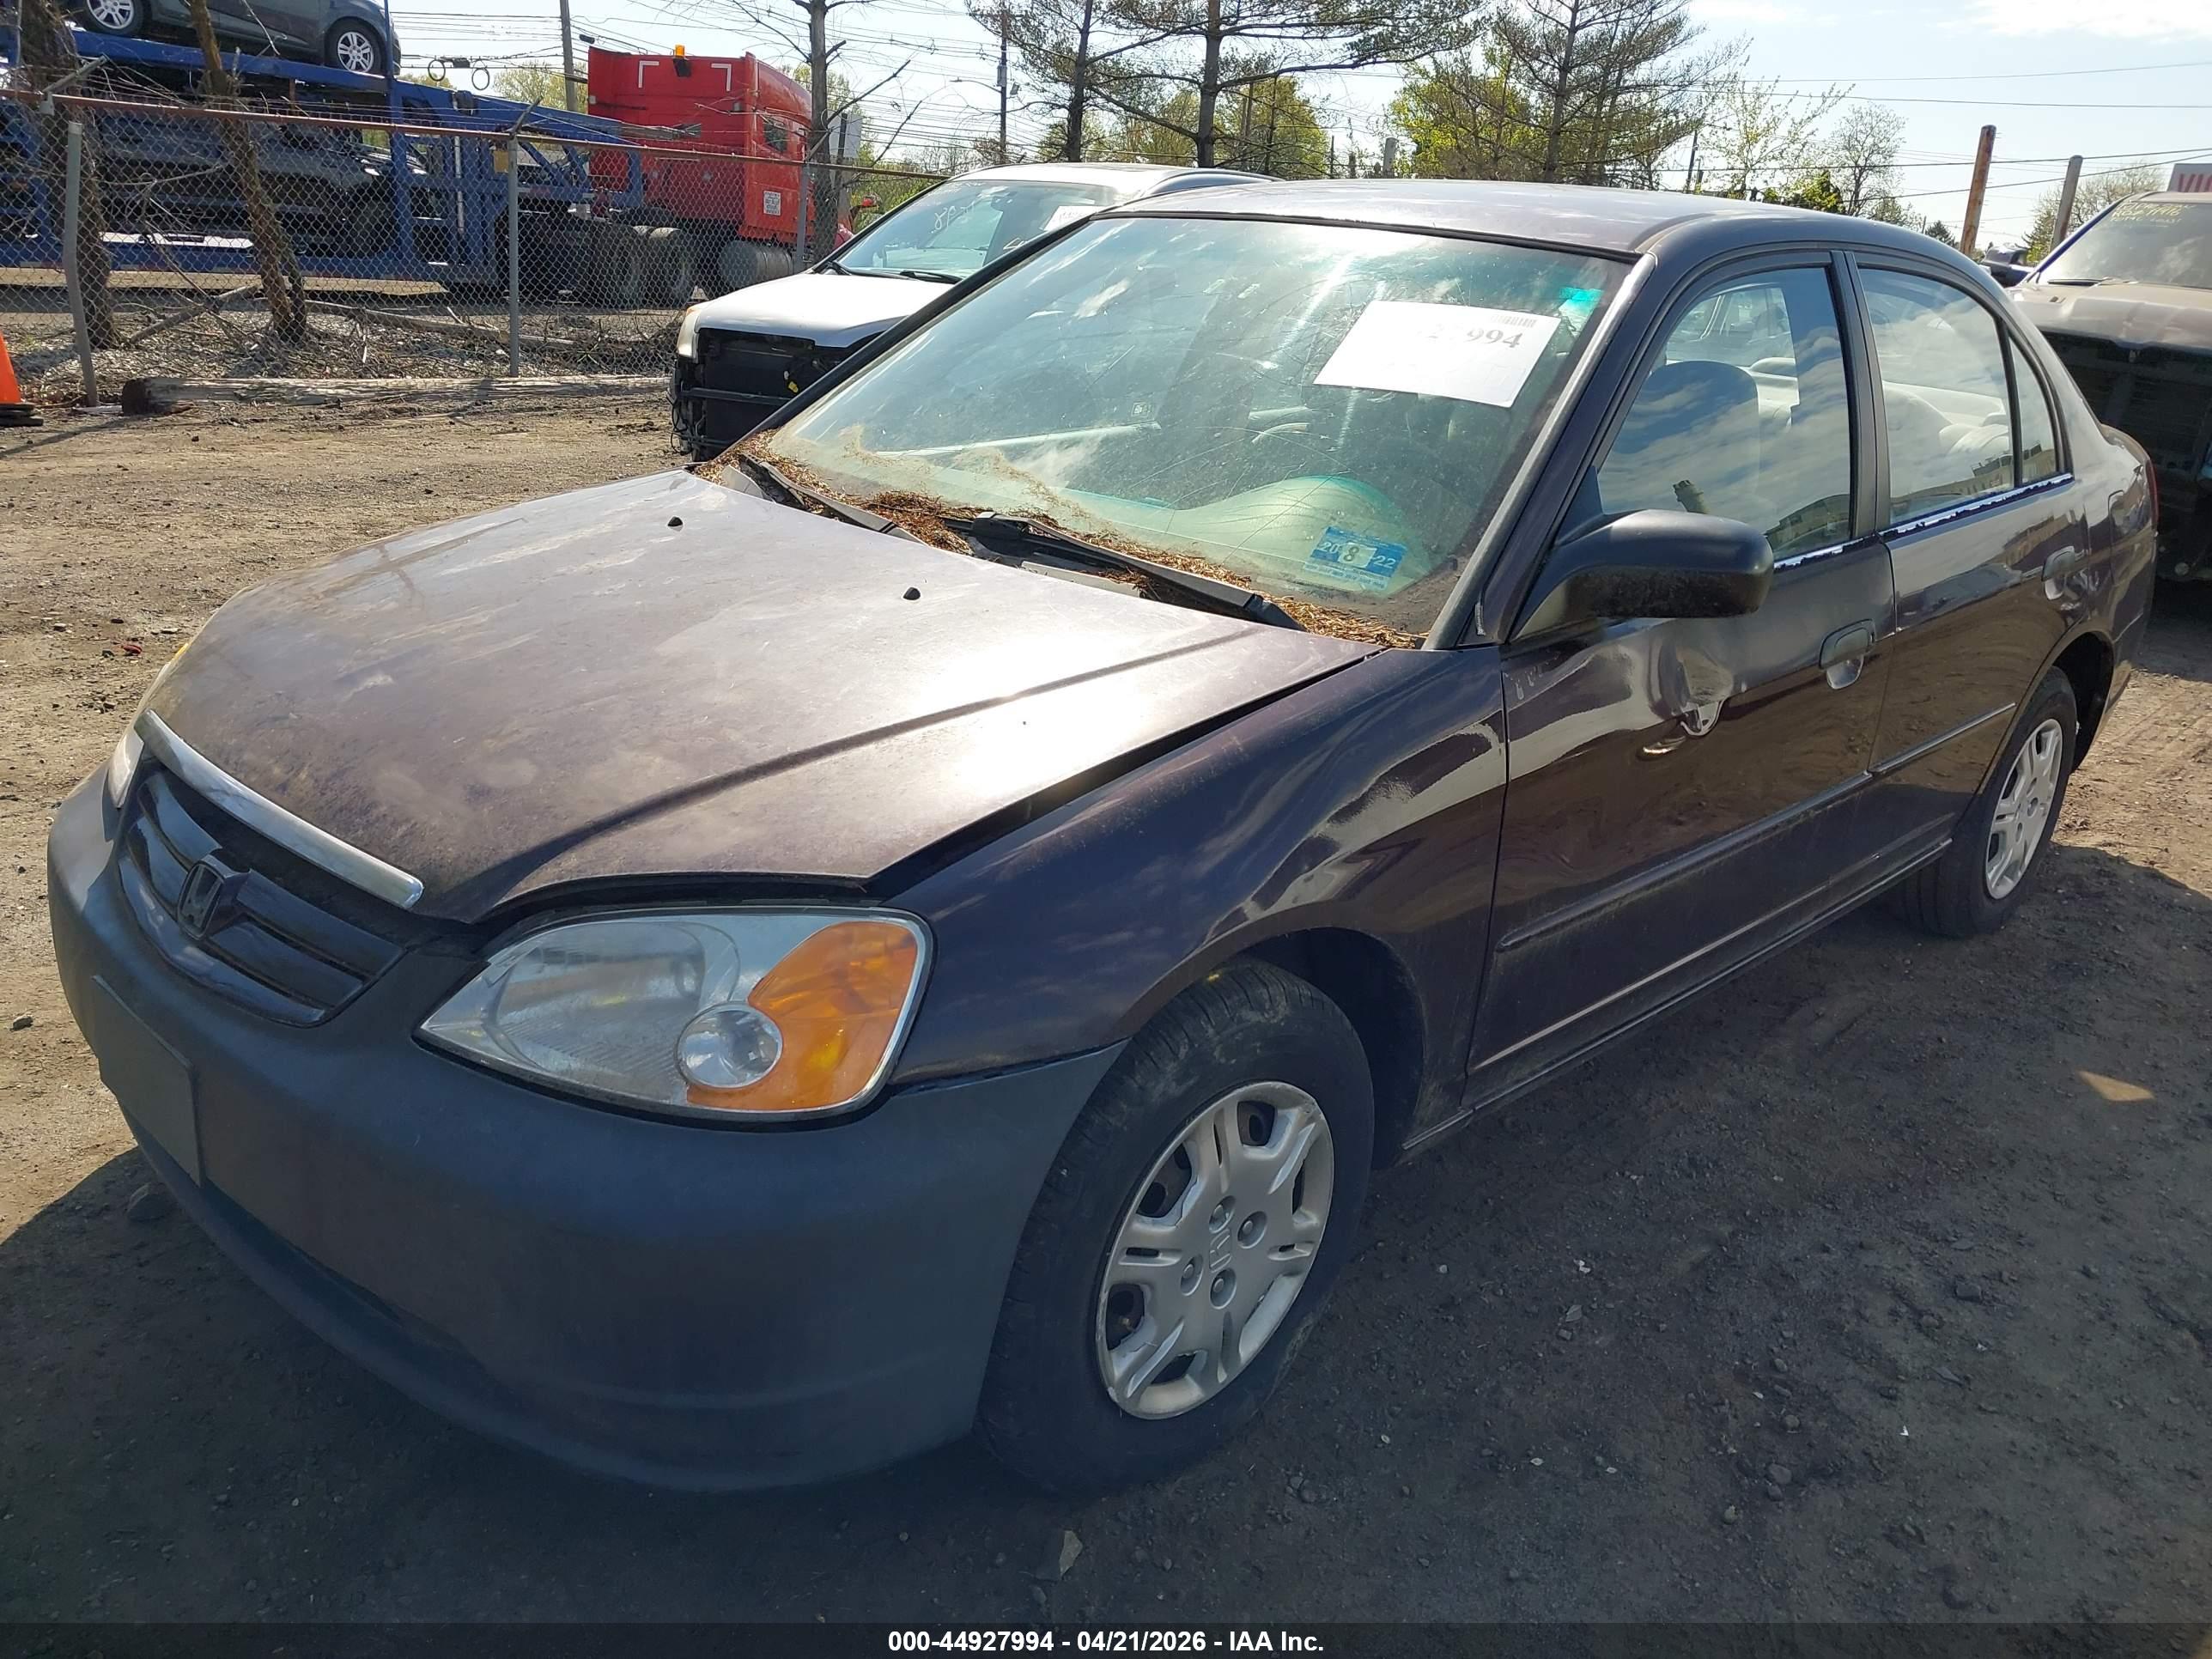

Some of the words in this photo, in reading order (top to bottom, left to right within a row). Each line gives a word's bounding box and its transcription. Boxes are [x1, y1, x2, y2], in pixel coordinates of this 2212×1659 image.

[1320, 541, 1340, 554] 20
[1343, 546, 1359, 562] 8
[1373, 555, 1396, 568] 22
